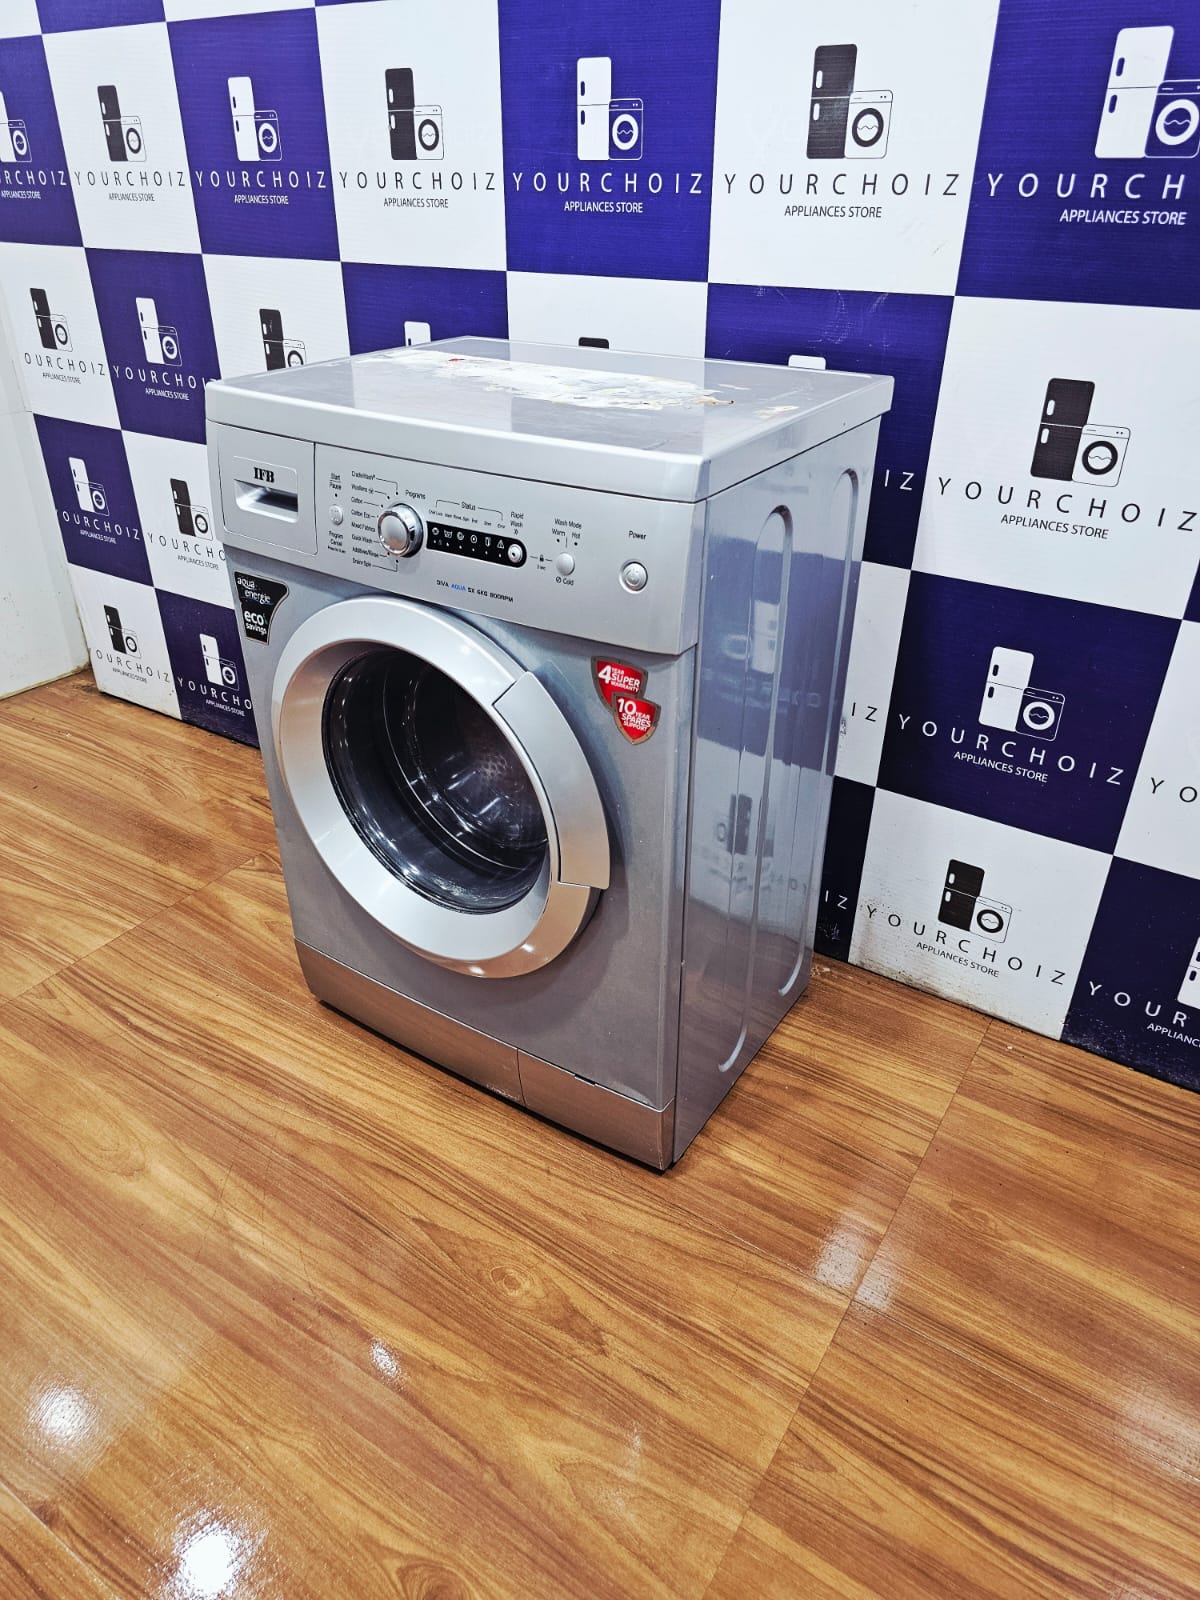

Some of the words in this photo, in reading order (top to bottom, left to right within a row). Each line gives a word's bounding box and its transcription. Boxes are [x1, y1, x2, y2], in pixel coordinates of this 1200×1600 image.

[0, 170, 67, 186] RCHOIZ
[74, 171, 186, 187] YOURCHOIZ
[195, 171, 327, 189] YOURCHOIZ
[339, 171, 496, 191] YOURCHOIZ
[512, 172, 703, 195] YOURCHOIZ
[724, 172, 961, 198] YOURCHOIZ
[986, 173, 1186, 200] YOURCH
[108, 192, 138, 202] APPLIANCES
[138, 193, 155, 202] STORE
[234, 194, 269, 204] APPLIANCES
[269, 195, 289, 205] STORE
[383, 197, 425, 209] APPLIANCES
[426, 198, 449, 209] STORE
[563, 201, 615, 213] APPLIANCES
[615, 202, 643, 214] STORE
[784, 204, 846, 218] APPLIANCES
[847, 206, 883, 219] STORE
[1059, 208, 1140, 224] APPLIANCES
[1141, 210, 1188, 226] STORE
[24, 352, 106, 376] OURCHOIZ
[112, 364, 206, 392] YOURCHOI
[145, 387, 173, 399] APPLIANCES
[173, 391, 190, 401] STORE
[253, 467, 275, 483] IFB
[405, 489, 426, 500] Programs
[937, 476, 1198, 532] YOURCHOIZ
[510, 511, 524, 520] Rapid
[62, 511, 141, 541] OURCHOIZ
[554, 518, 568, 527] Wash
[568, 520, 582, 530] Mode
[1000, 513, 1069, 534] APPLIANCES
[1070, 523, 1110, 540] STORE
[551, 528, 566, 537] Warm
[571, 531, 581, 540] Hot
[628, 530, 647, 540] Power
[147, 531, 226, 561] YOURCHO
[204, 560, 219, 570] STORE
[236, 577, 255, 590] aqua
[436, 579, 449, 588] DIVA
[450, 583, 467, 591] AQUA
[562, 578, 575, 586] Cold
[244, 589, 271, 605] energie
[244, 610, 264, 626] eco
[245, 622, 267, 636] savings
[96, 649, 171, 684] OURCHOIZ
[598, 665, 612, 684] 4
[611, 667, 624, 675] YEAR
[610, 681, 640, 693] WARRANTY
[611, 673, 640, 688] SUPER
[177, 677, 252, 710] YOURCHO
[617, 698, 637, 715] 10
[635, 711, 650, 720] YEAR
[621, 713, 651, 728] SPARES
[623, 720, 649, 732] SUPPORT
[898, 713, 1125, 786] YOURCHOIZ
[953, 751, 1014, 775] APPLIANCES
[1014, 766, 1049, 784] STORE
[865, 904, 1066, 986] YOURCHOIZ
[915, 941, 970, 968] APPLIANCES
[970, 961, 1000, 979] STORE
[1146, 1022, 1200, 1049] APPLIANC
